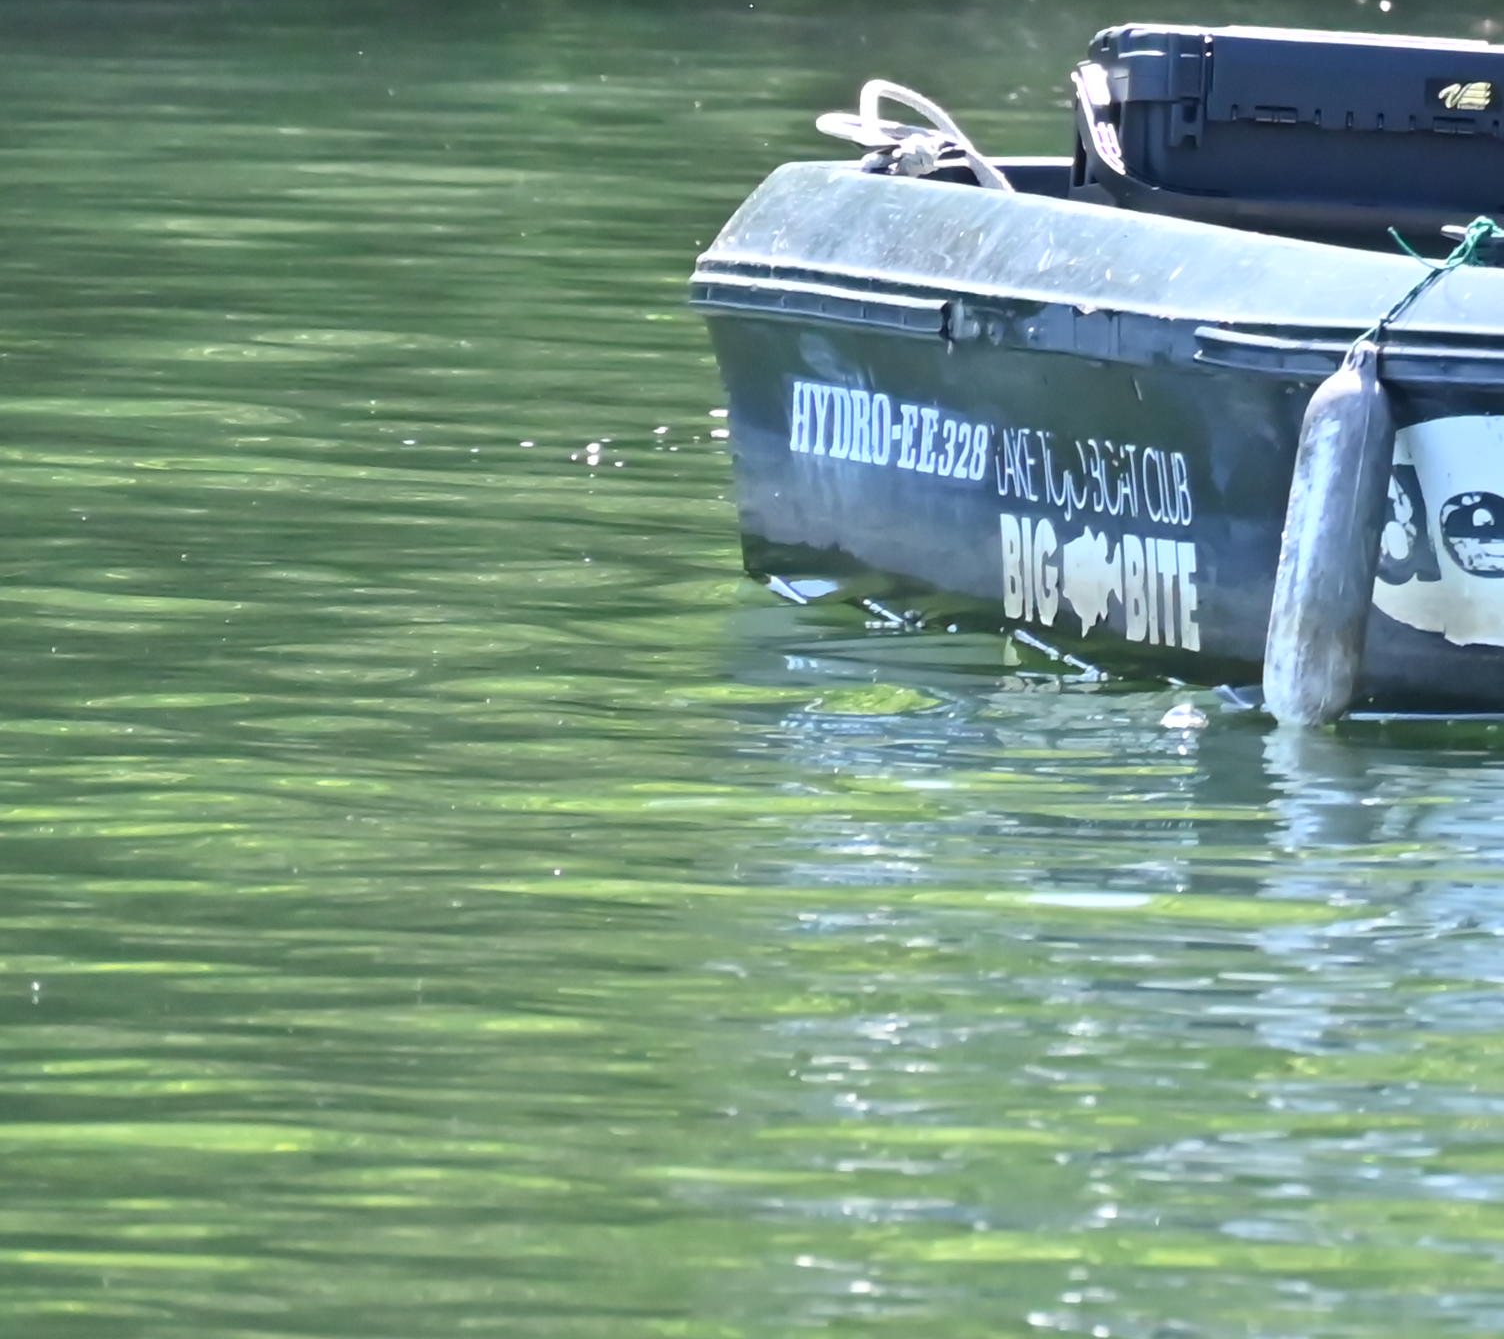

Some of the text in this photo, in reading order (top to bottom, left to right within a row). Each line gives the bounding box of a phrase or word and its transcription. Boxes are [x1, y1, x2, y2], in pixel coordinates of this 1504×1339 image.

[1142, 446, 1193, 527] CLUB
[1000, 513, 1201, 651] BIG BITE
